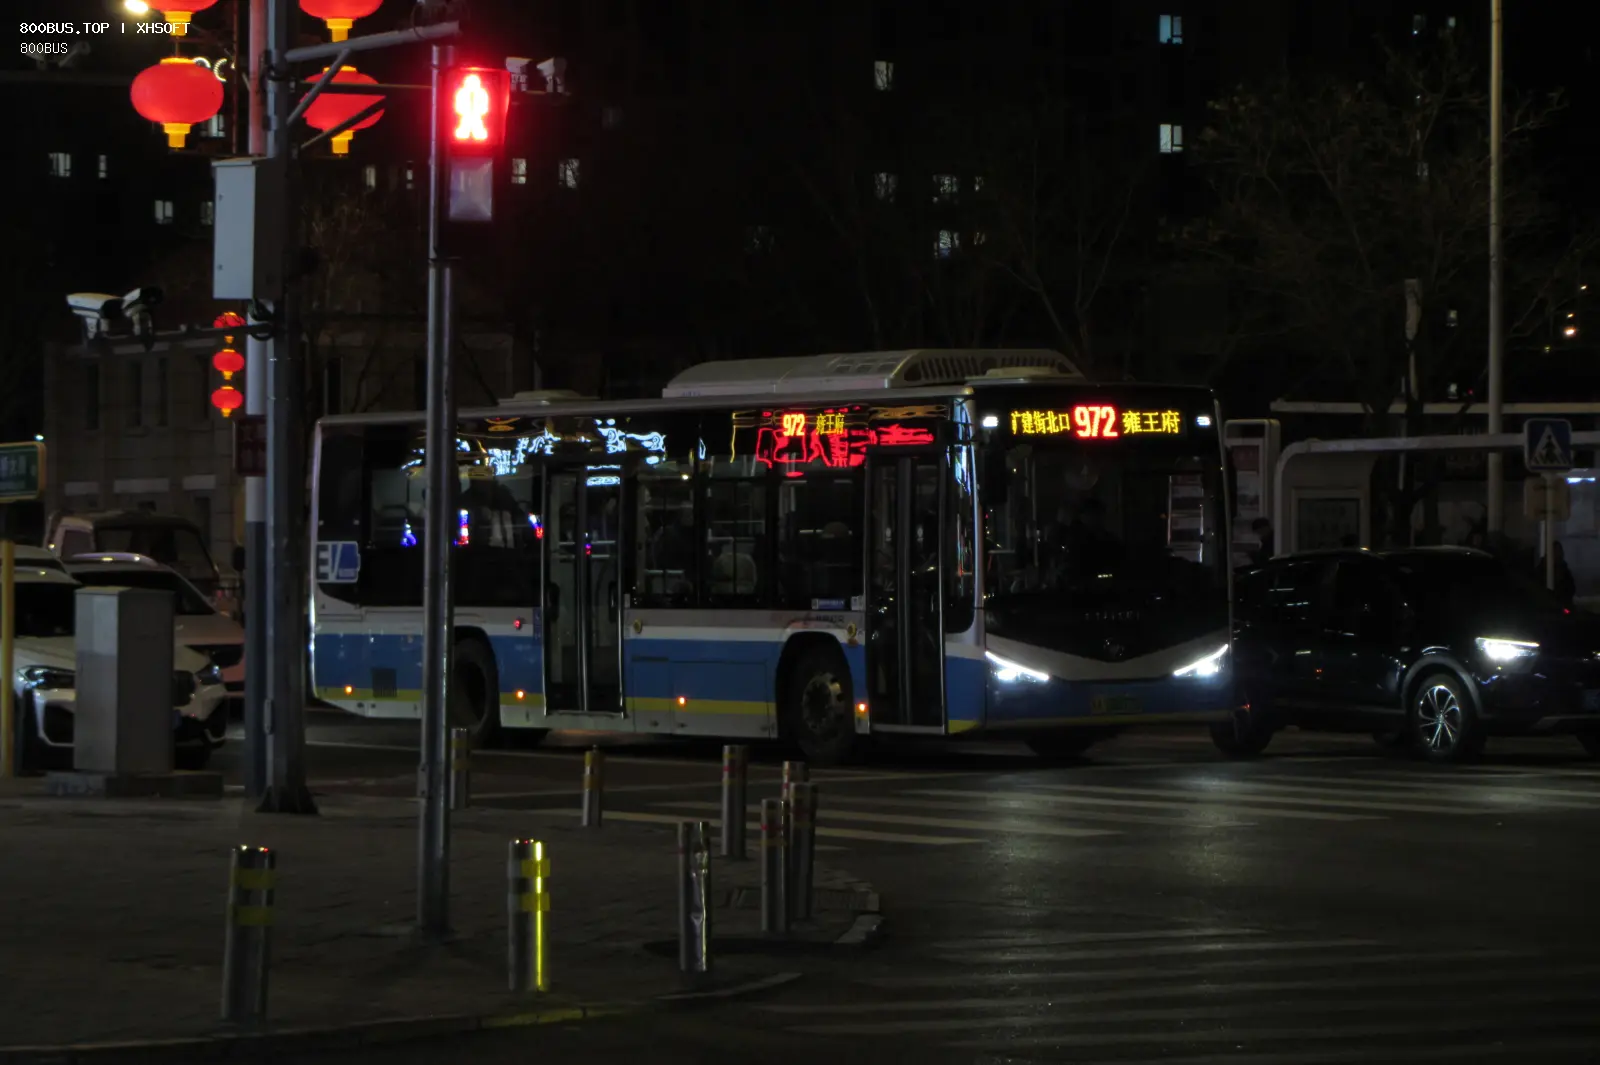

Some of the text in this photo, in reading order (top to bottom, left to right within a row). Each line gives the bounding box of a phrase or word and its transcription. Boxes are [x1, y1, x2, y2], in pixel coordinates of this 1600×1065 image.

[782, 413, 806, 437] 972
[1074, 406, 1119, 438] 972
[1121, 409, 1181, 434] 雍王府
